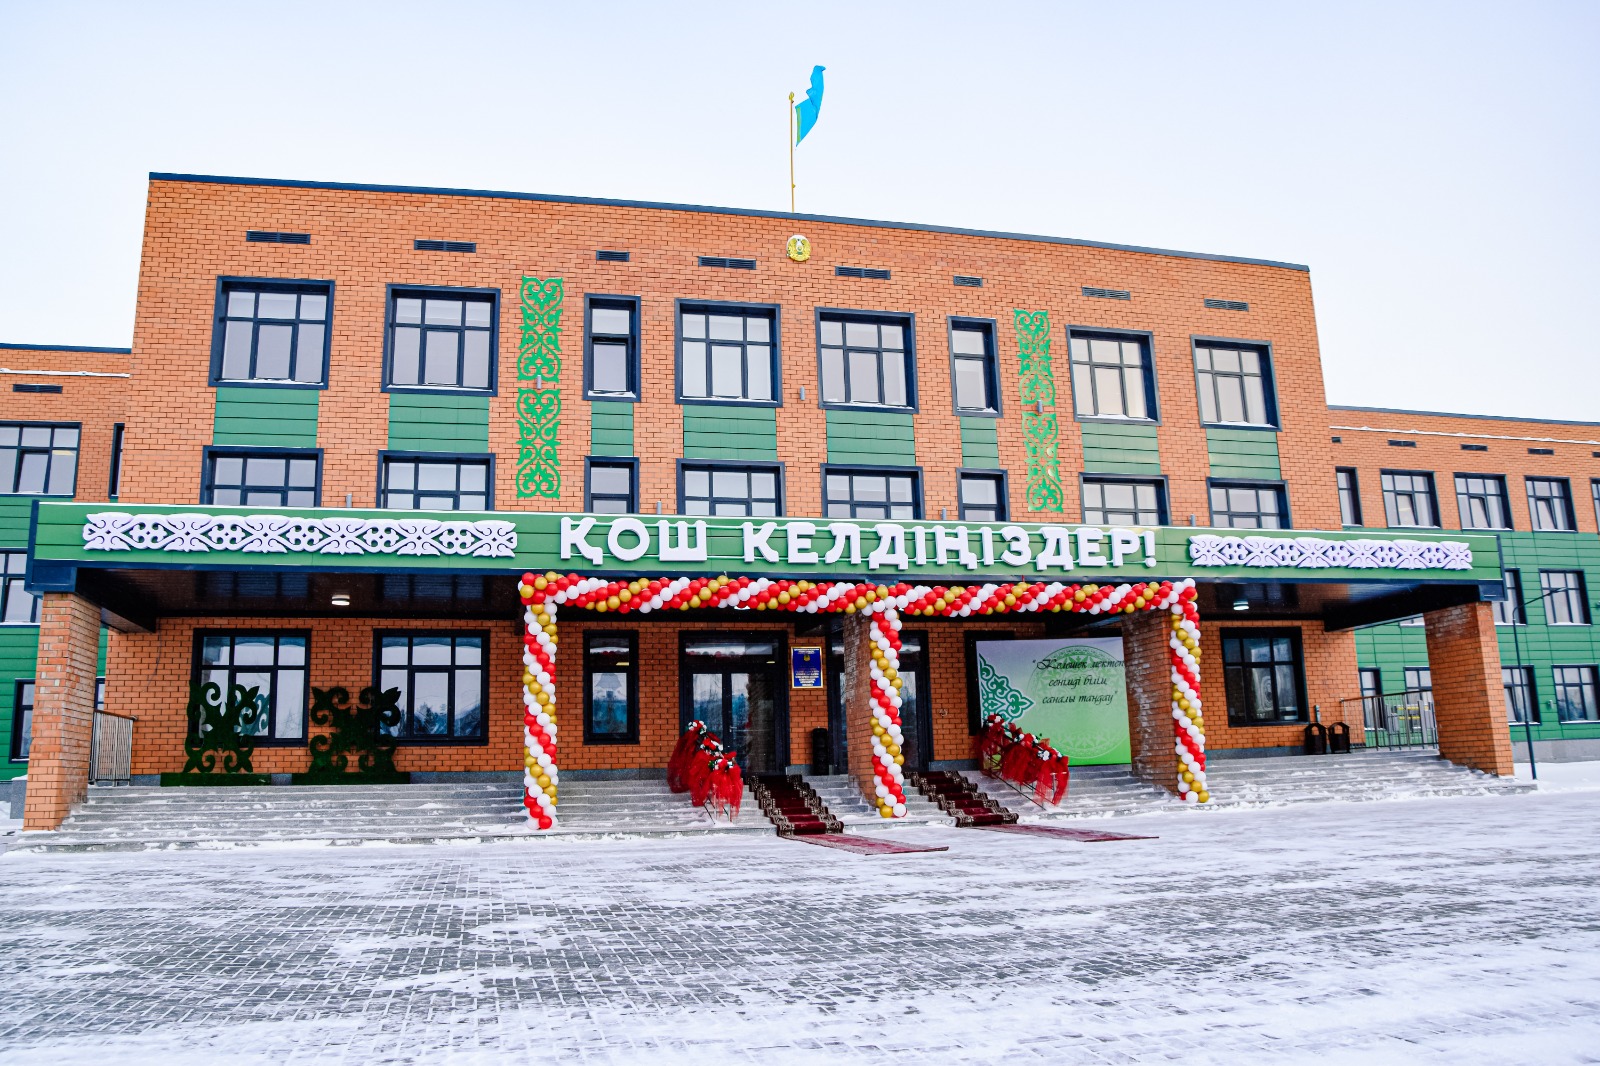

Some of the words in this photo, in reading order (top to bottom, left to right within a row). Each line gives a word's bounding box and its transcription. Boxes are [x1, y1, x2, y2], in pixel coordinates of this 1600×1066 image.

[560, 516, 708, 565] ҚОШ
[744, 521, 1157, 571] КЕЛДІҢІЗДЕР!
[1042, 696, 1075, 705] саналы
